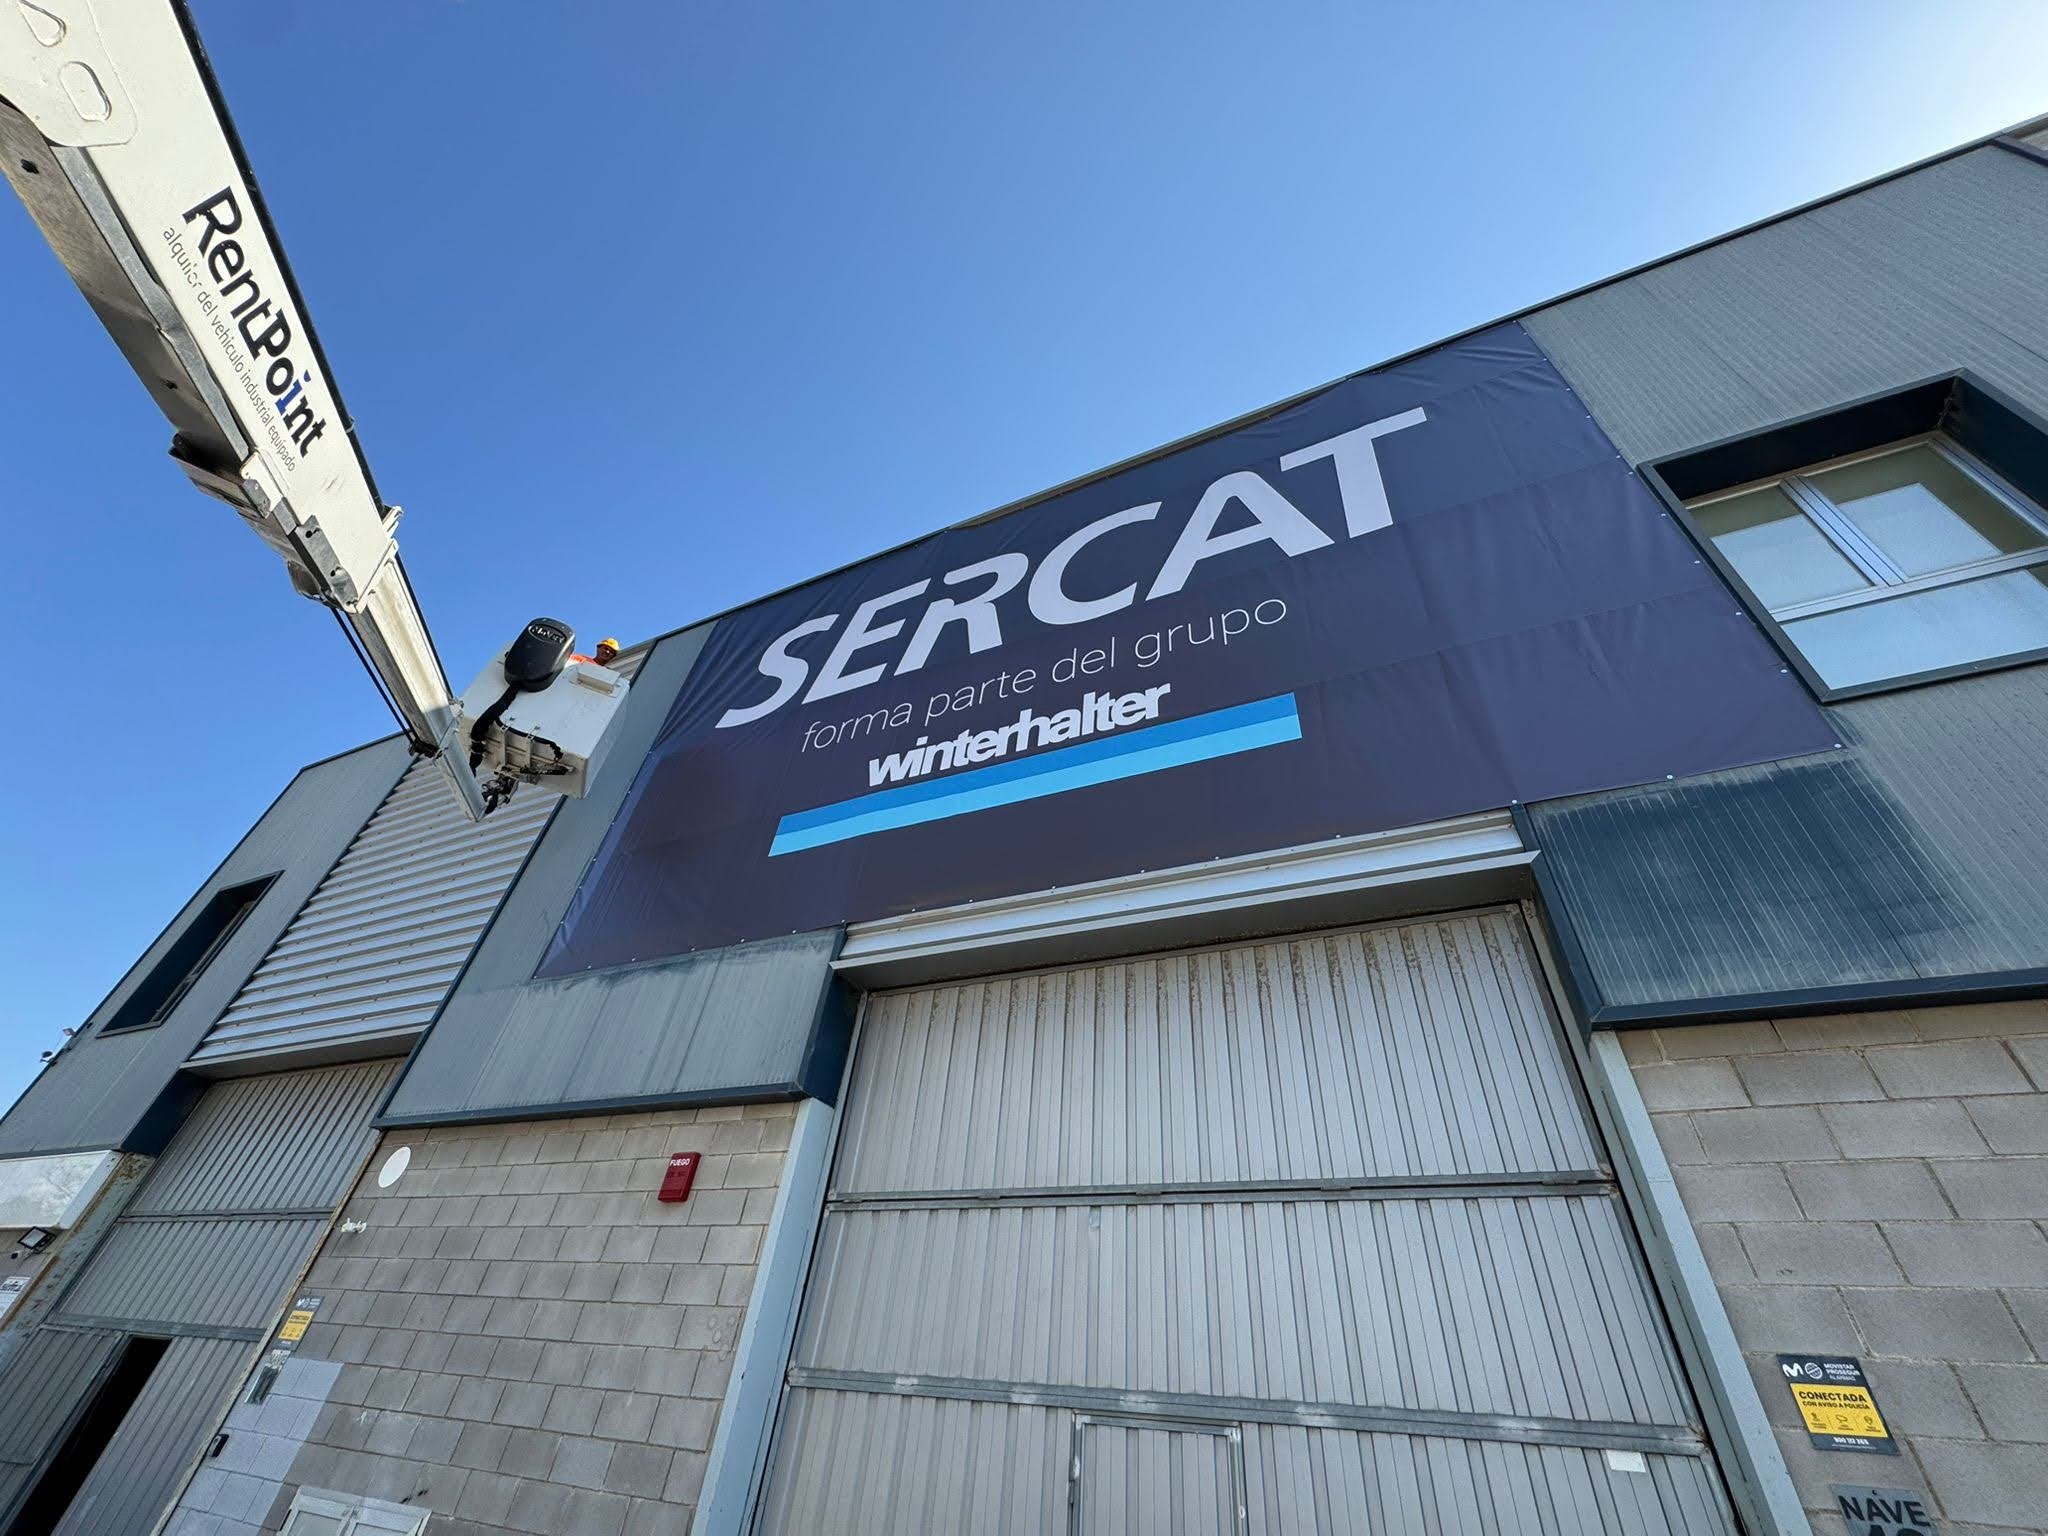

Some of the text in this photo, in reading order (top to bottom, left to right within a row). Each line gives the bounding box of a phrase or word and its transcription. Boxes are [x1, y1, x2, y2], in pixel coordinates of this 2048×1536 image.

[182, 185, 327, 459] RentPoint
[197, 291, 218, 317] del
[240, 369, 274, 428] industrial
[268, 424, 296, 472] equipado
[715, 406, 1427, 729] SERCAT
[801, 598, 1287, 753] forma parte del grupo
[869, 683, 1171, 787] winterhalter
[670, 1158, 691, 1167] FUEGO
[1798, 1390, 1867, 1403] CONECTADA
[1818, 1401, 1838, 1409] AVISO
[1838, 1495, 1932, 1527] NAVE
